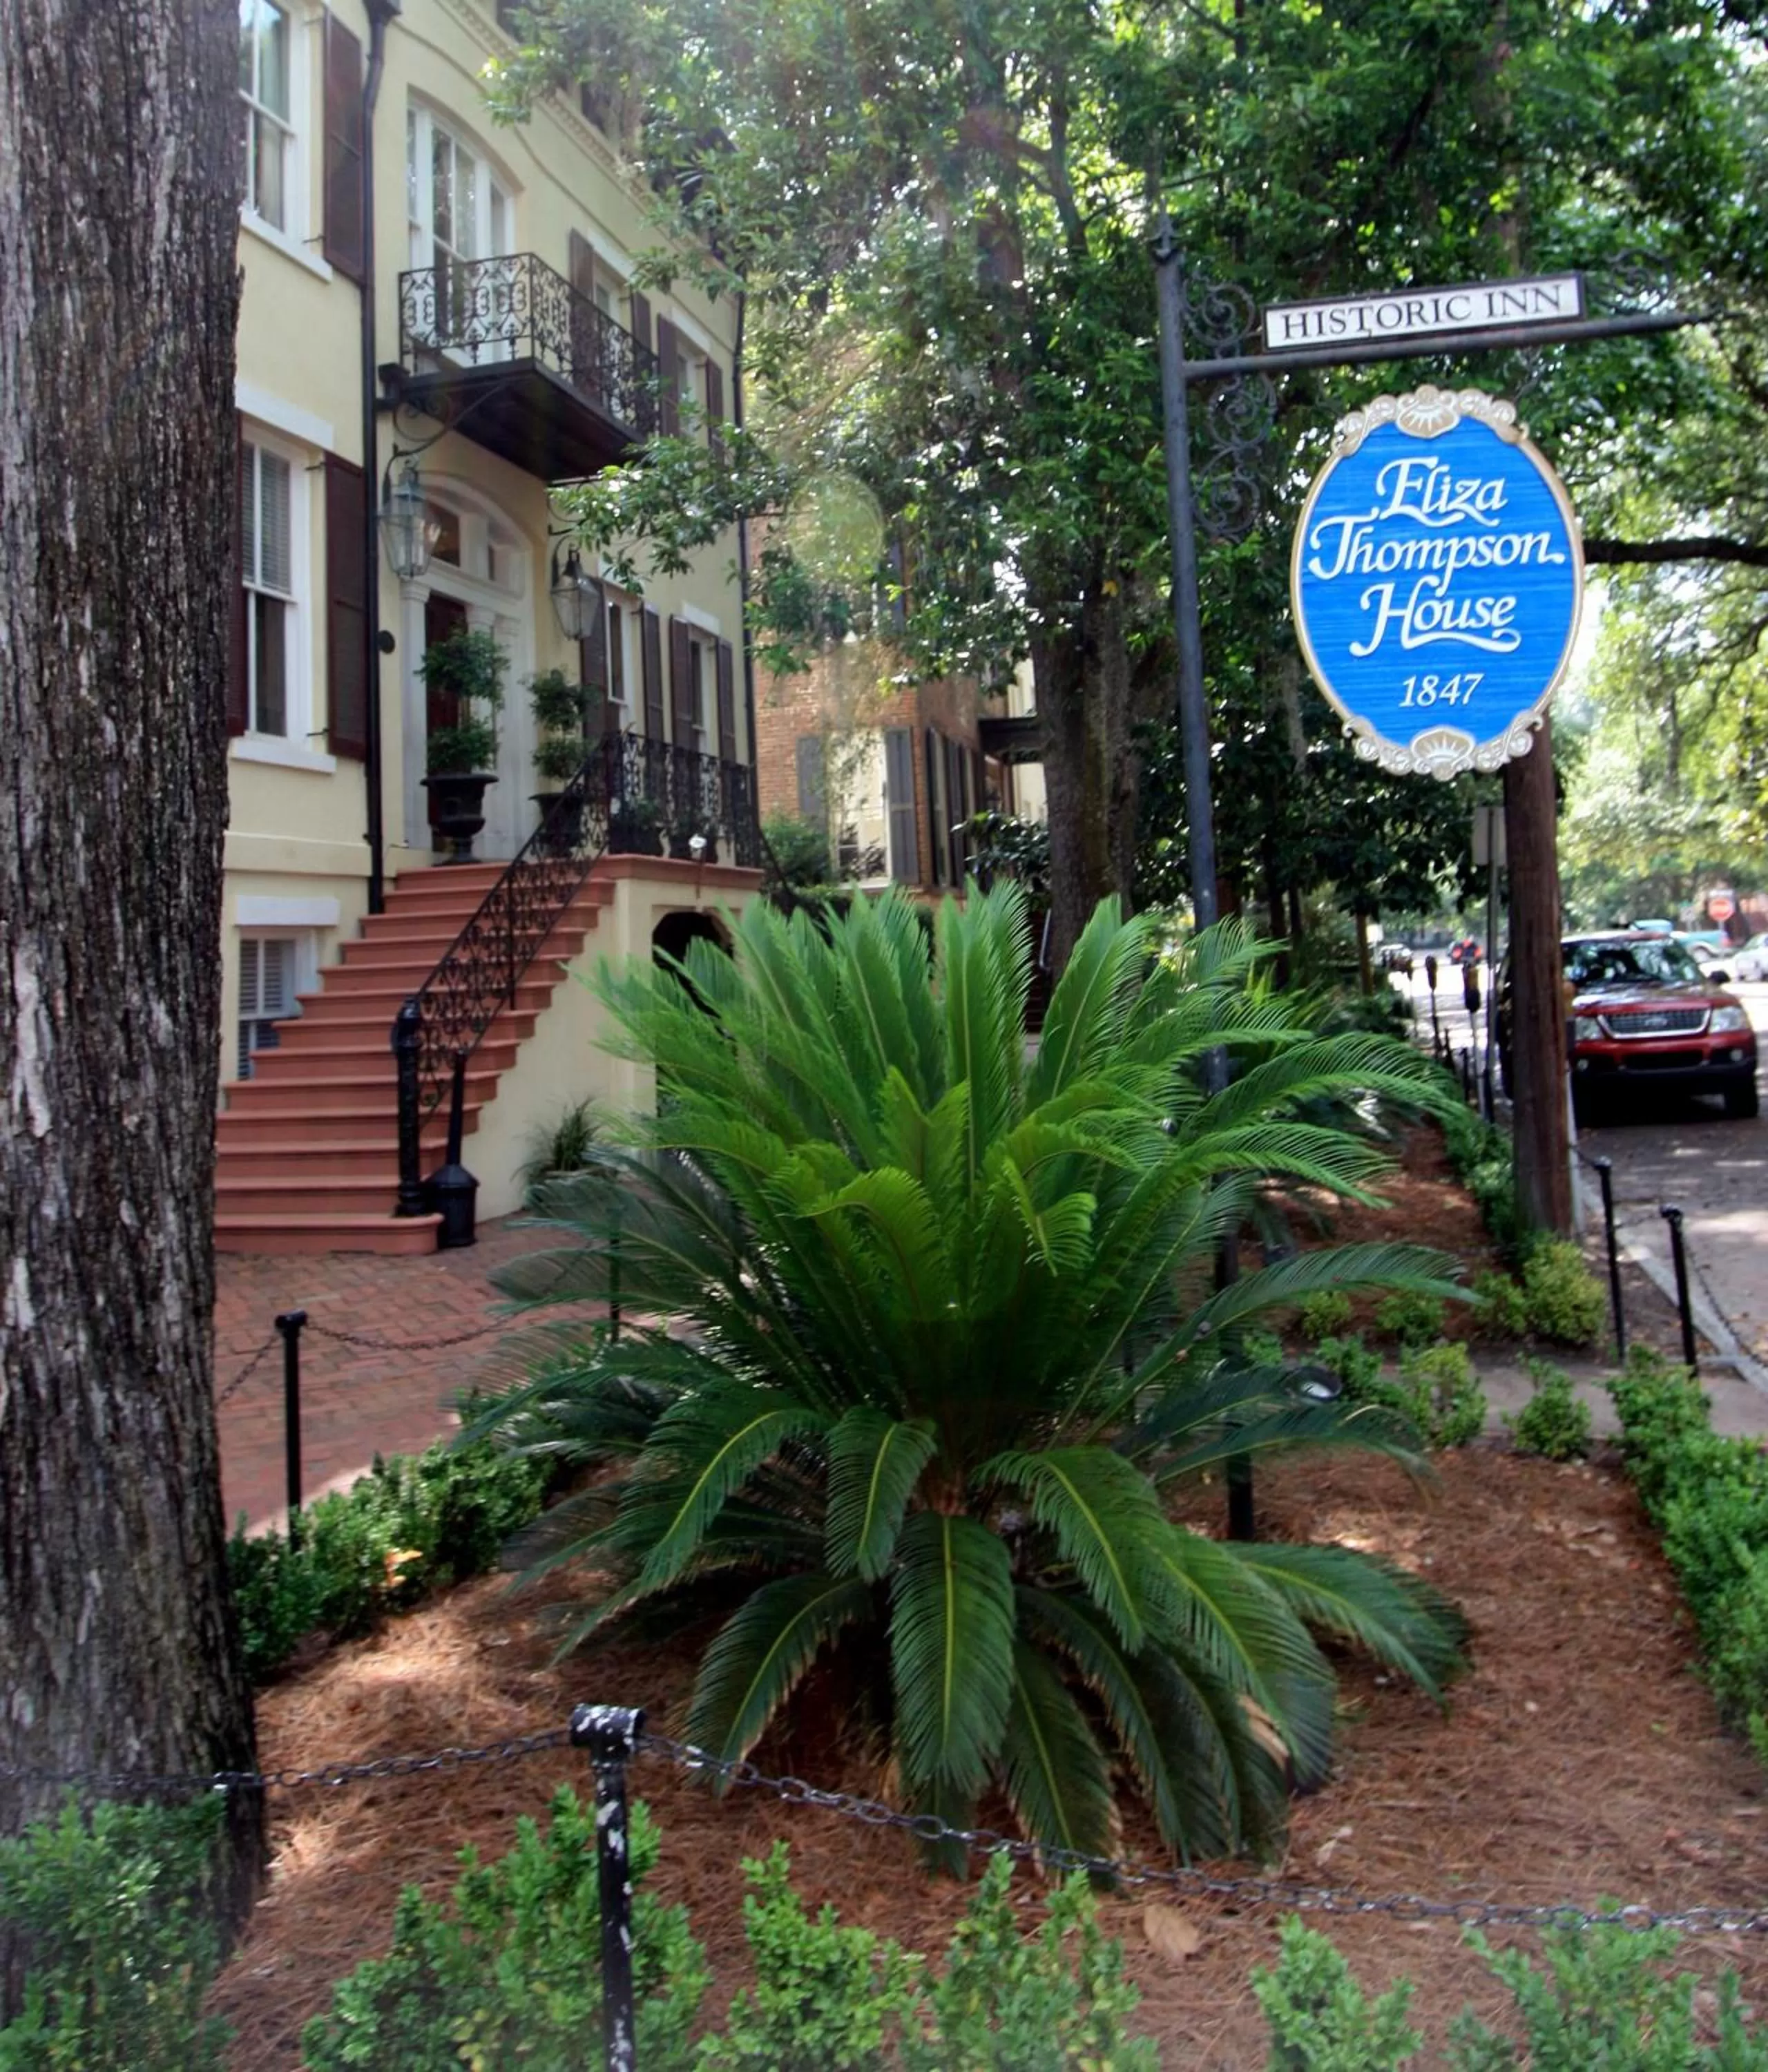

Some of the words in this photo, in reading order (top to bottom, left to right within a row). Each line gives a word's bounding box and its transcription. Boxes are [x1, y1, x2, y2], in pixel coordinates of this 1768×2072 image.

[1282, 295, 1470, 339] HISTORIC
[1487, 285, 1565, 317] INN
[1376, 457, 1507, 527] Eliza
[1308, 507, 1565, 597] Thompson
[1349, 575, 1521, 656] House
[1399, 673, 1484, 707] 1847
